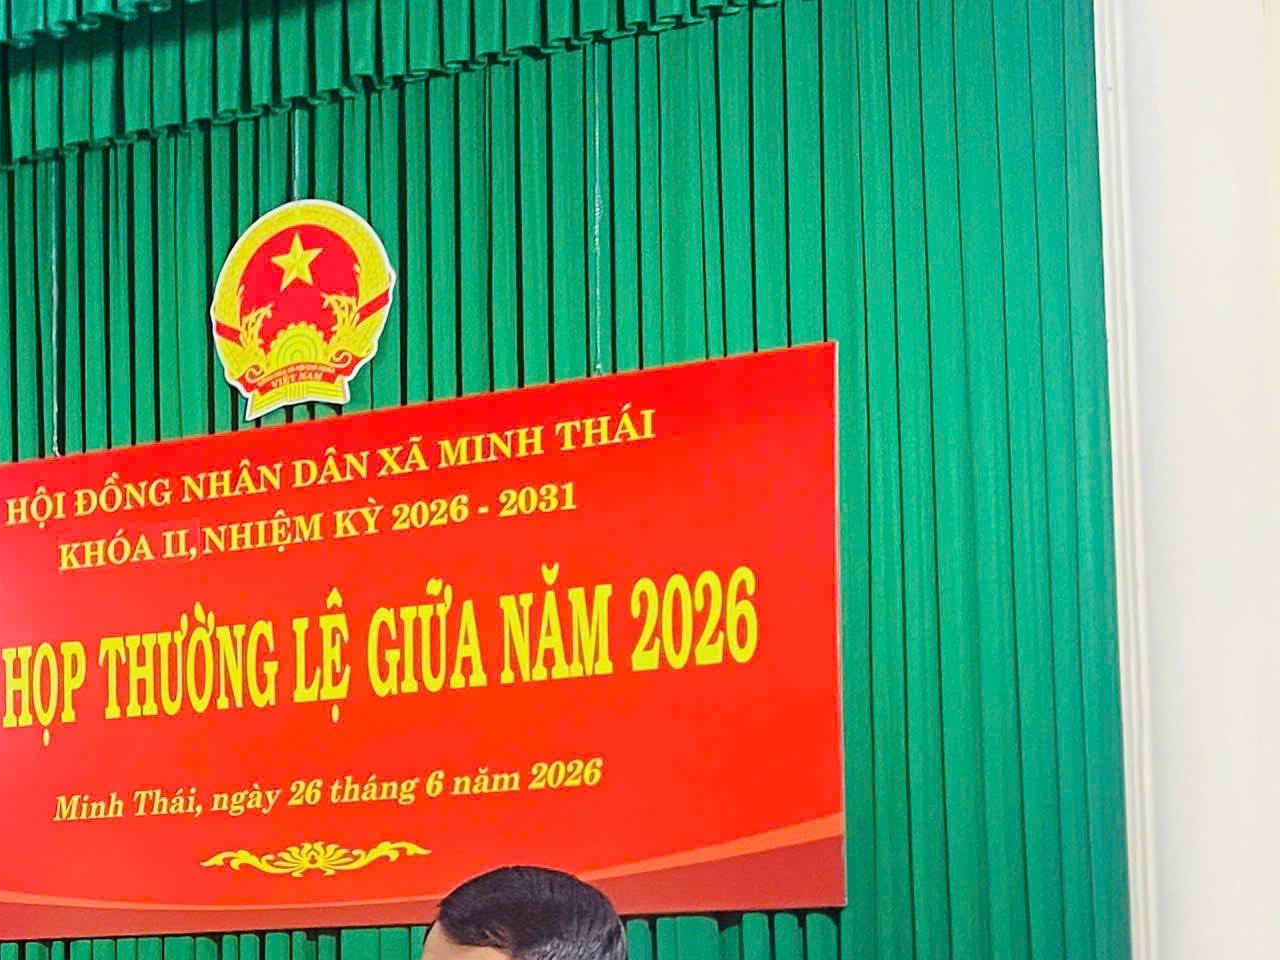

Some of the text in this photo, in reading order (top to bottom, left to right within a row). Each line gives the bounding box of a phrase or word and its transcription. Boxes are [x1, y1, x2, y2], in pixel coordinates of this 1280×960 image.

[6, 402, 656, 529] HỘI ĐỒNG NHÂN DÂN XÃ MINH THÁI
[58, 481, 577, 572] KHÓA II, NHIỆM KỲ 2026 - 2031
[1, 640, 87, 747] HỌP
[98, 601, 279, 720] THƯỜNG
[291, 586, 351, 723] LỆ
[367, 577, 488, 698] GIỮA
[498, 562, 614, 685] NĂM
[630, 565, 758, 672] 2026
[52, 757, 603, 822] Minh Thái, ngày 26 tháng 6 năm 2026
